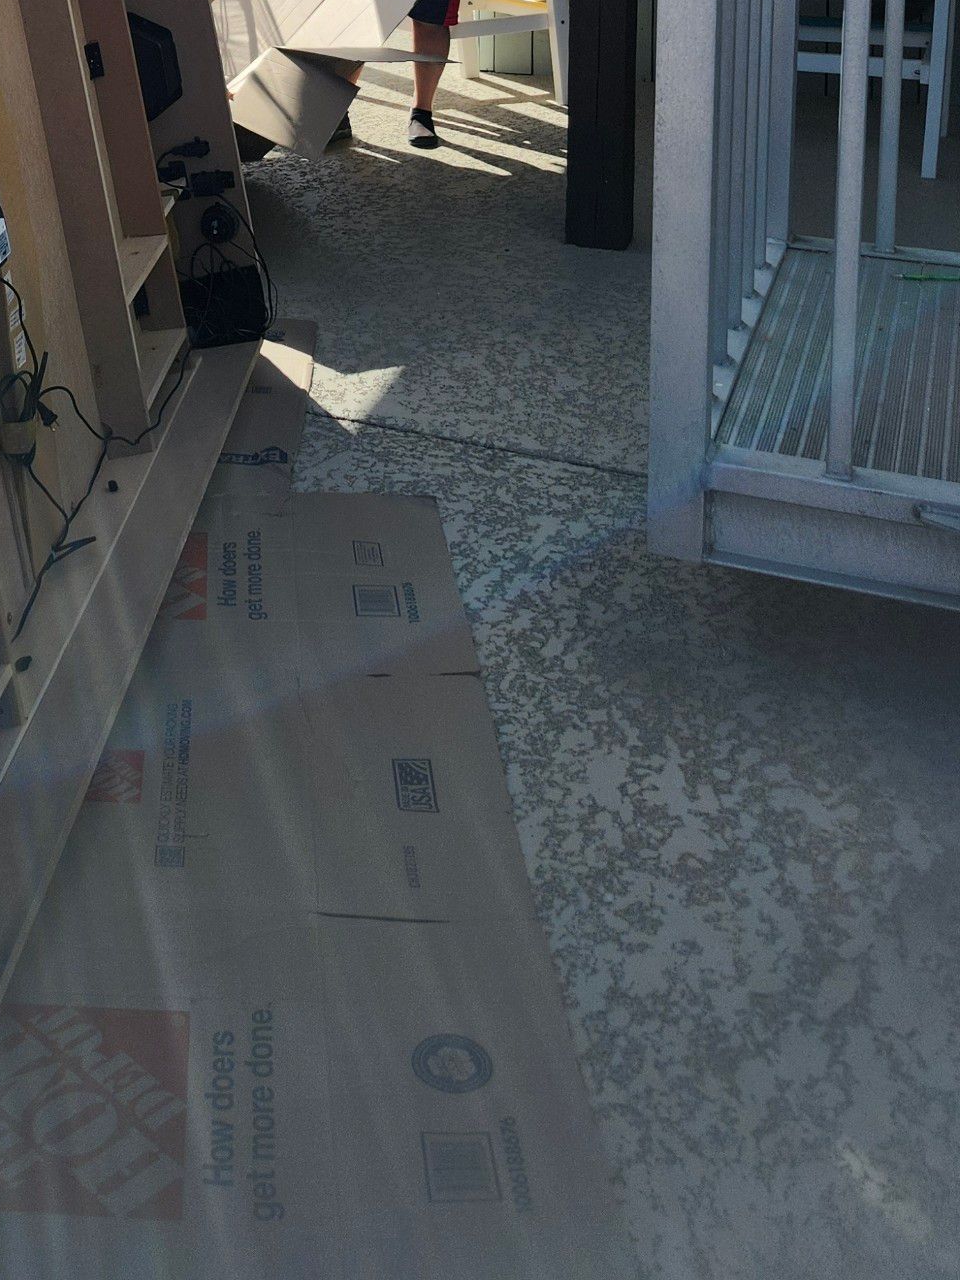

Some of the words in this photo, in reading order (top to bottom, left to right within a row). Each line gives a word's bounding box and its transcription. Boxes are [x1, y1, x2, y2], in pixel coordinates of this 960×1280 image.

[218, 542, 237, 576] doers
[243, 528, 262, 561] done.
[217, 579, 237, 607] How
[248, 564, 262, 595] more
[245, 598, 268, 620] get
[204, 1030, 235, 1111] doers
[252, 1085, 275, 1161] more
[203, 1120, 234, 1187] How
[247, 1170, 285, 1220] get
